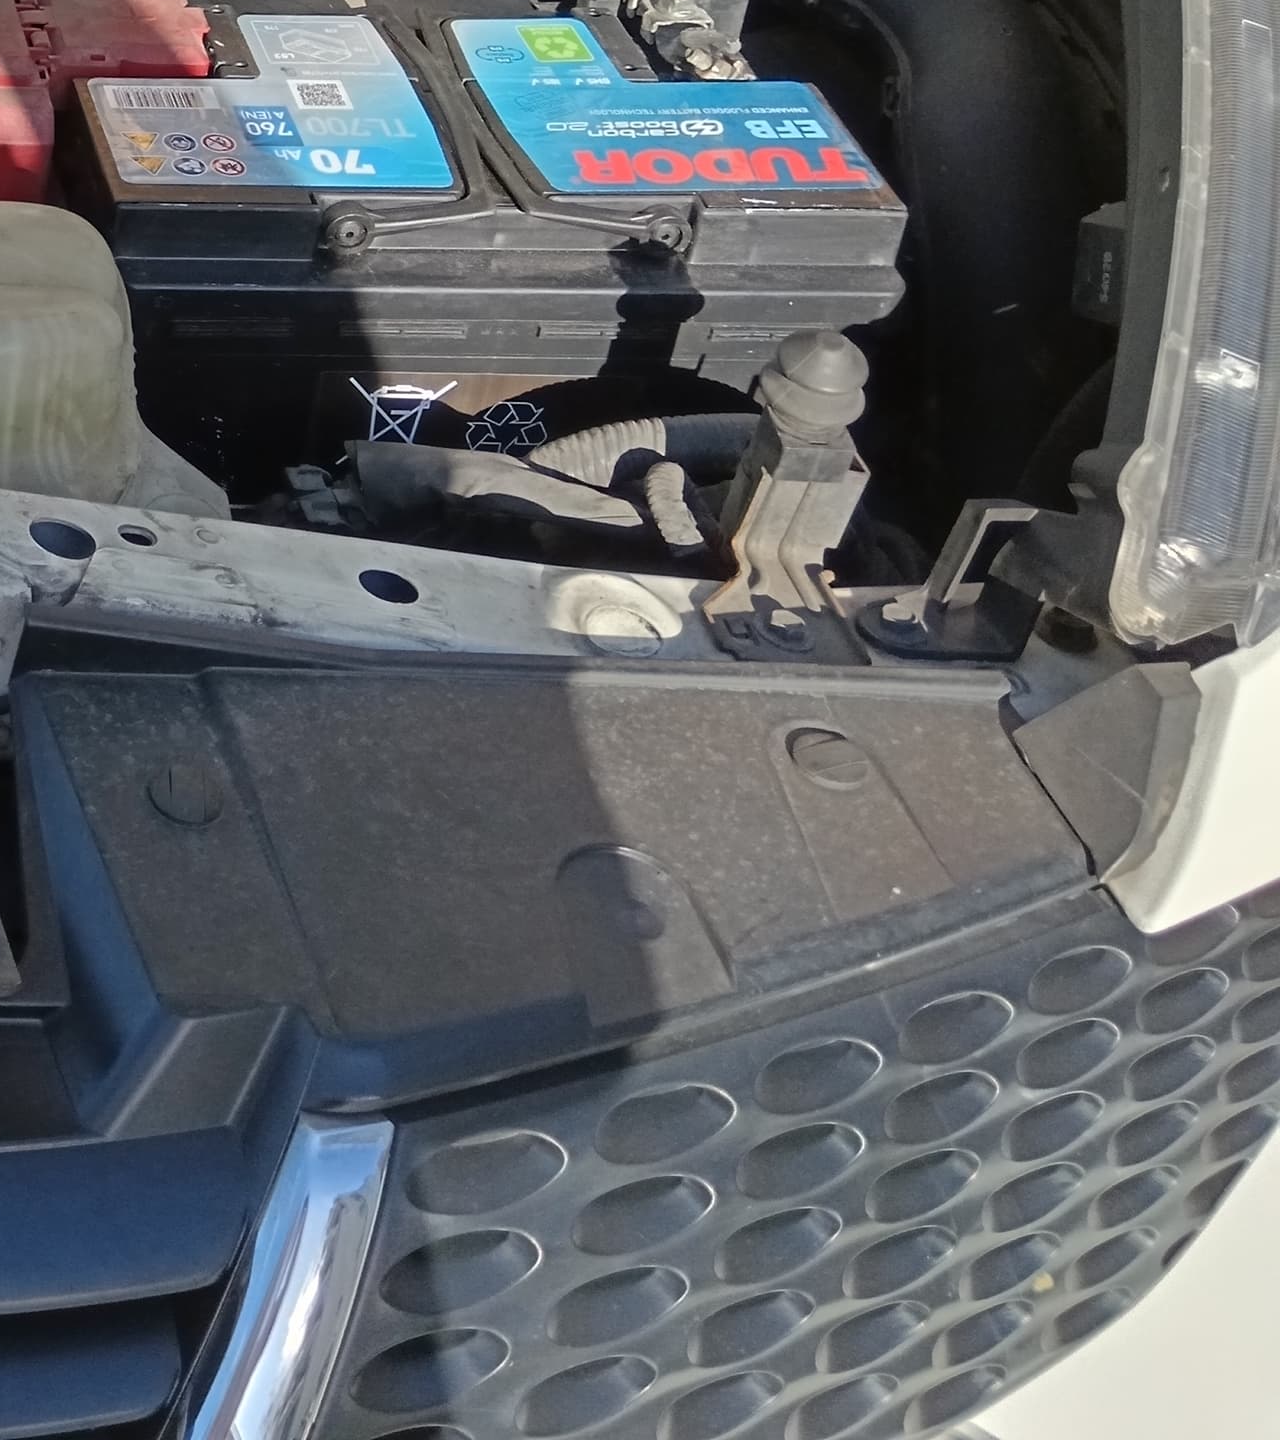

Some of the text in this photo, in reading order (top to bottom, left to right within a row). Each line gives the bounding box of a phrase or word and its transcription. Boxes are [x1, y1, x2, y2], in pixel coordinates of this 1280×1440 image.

[589, 108, 655, 116] TECHNOLOGY
[245, 122, 294, 137] 760
[587, 129, 681, 139] carbon
[744, 119, 830, 139] EFB
[274, 148, 377, 175] 70 Ah
[573, 147, 869, 185] TUDOR
